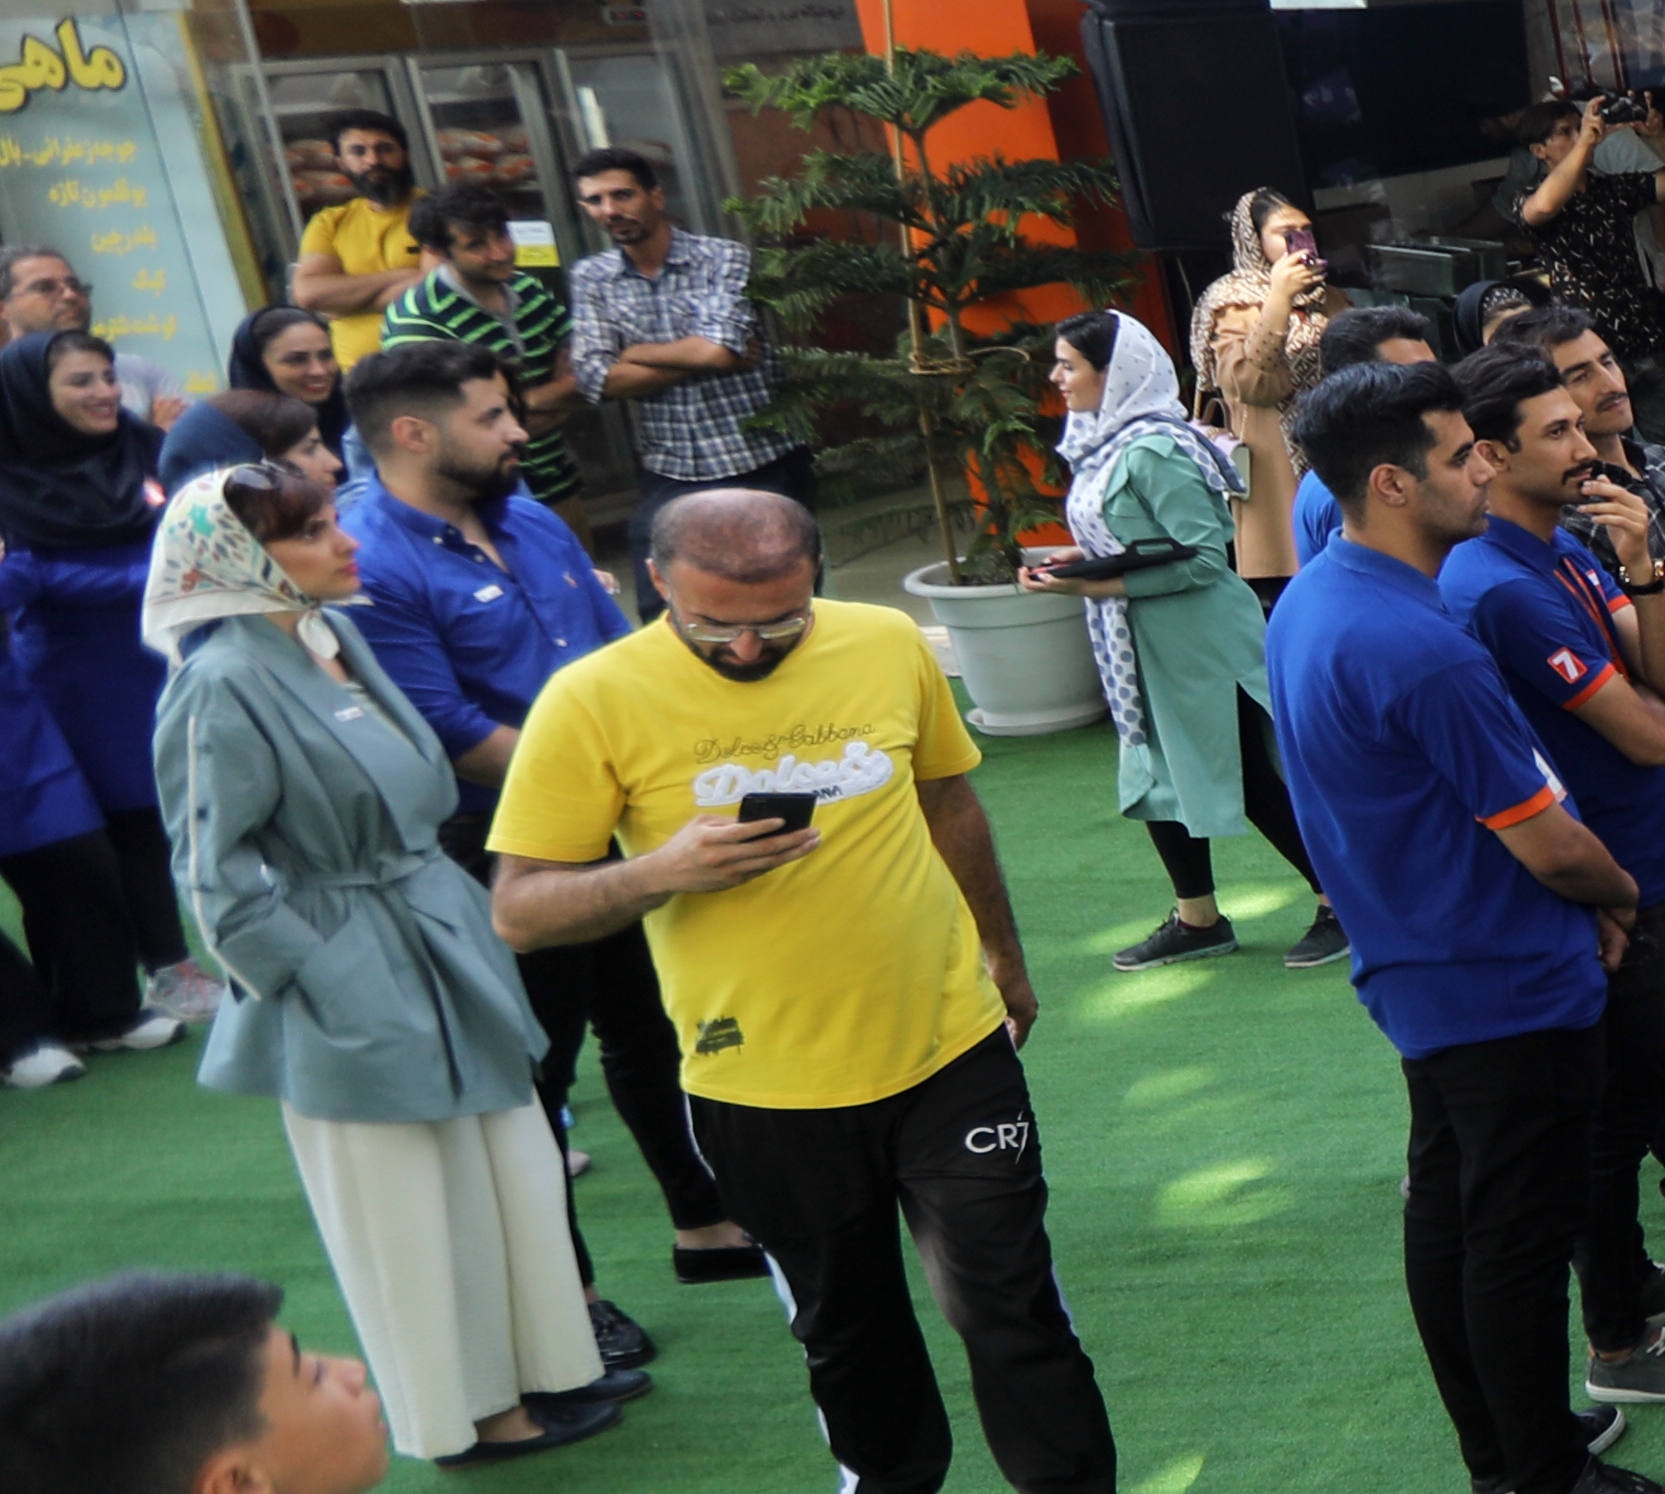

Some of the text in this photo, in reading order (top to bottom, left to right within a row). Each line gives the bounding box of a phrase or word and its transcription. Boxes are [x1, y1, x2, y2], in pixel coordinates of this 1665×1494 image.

[0, 14, 127, 112] ماهی
[1551, 649, 1580, 680] 7
[964, 1110, 1030, 1165] CR7
